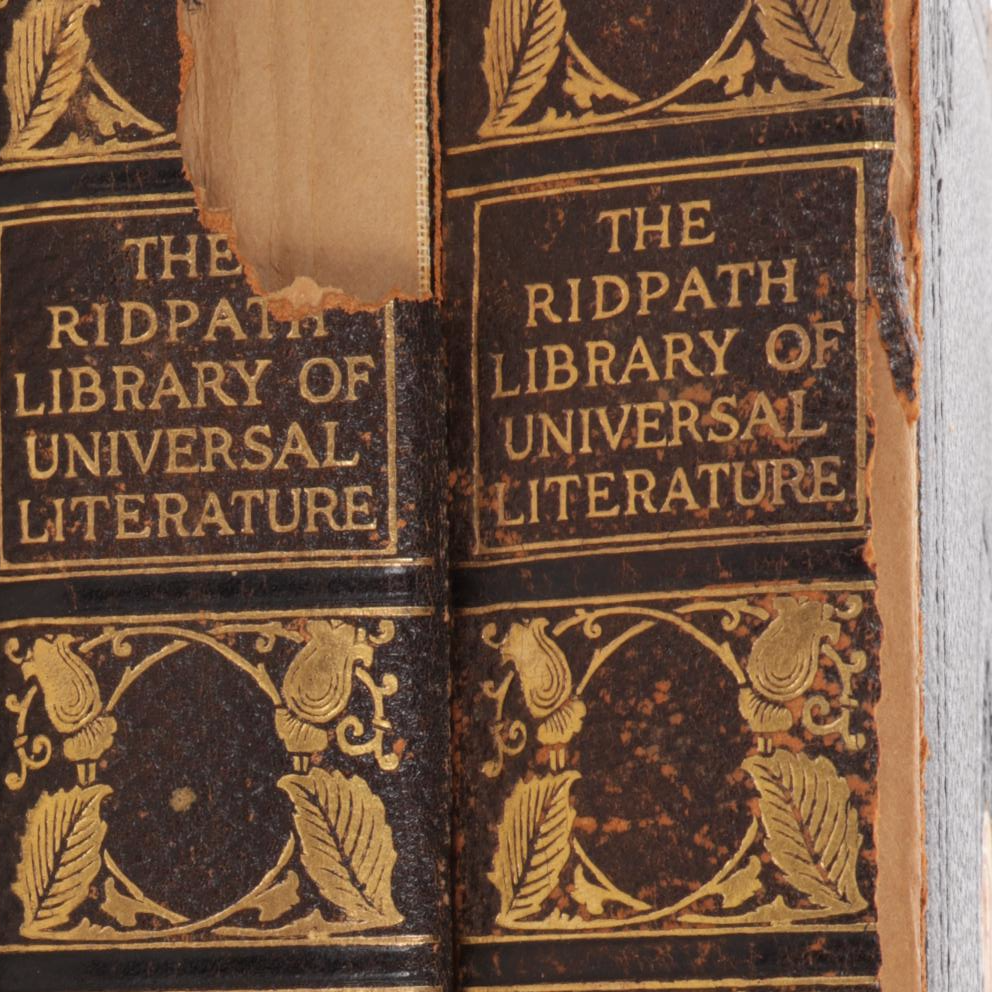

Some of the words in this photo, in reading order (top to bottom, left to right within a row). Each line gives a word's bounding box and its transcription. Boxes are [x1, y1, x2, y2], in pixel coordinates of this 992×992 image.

[124, 233, 243, 281] THE
[598, 199, 717, 254] THE
[524, 258, 799, 327] RIDPATH
[14, 359, 273, 418] LIBRARY
[299, 355, 376, 404] OF
[489, 328, 740, 400] LIBRARY
[765, 320, 845, 373] OF
[25, 421, 360, 480] UNIVERSAL
[504, 389, 828, 461] UNIVERSAL
[19, 485, 378, 544] LITERATURE
[494, 455, 846, 527] LITERATURE
